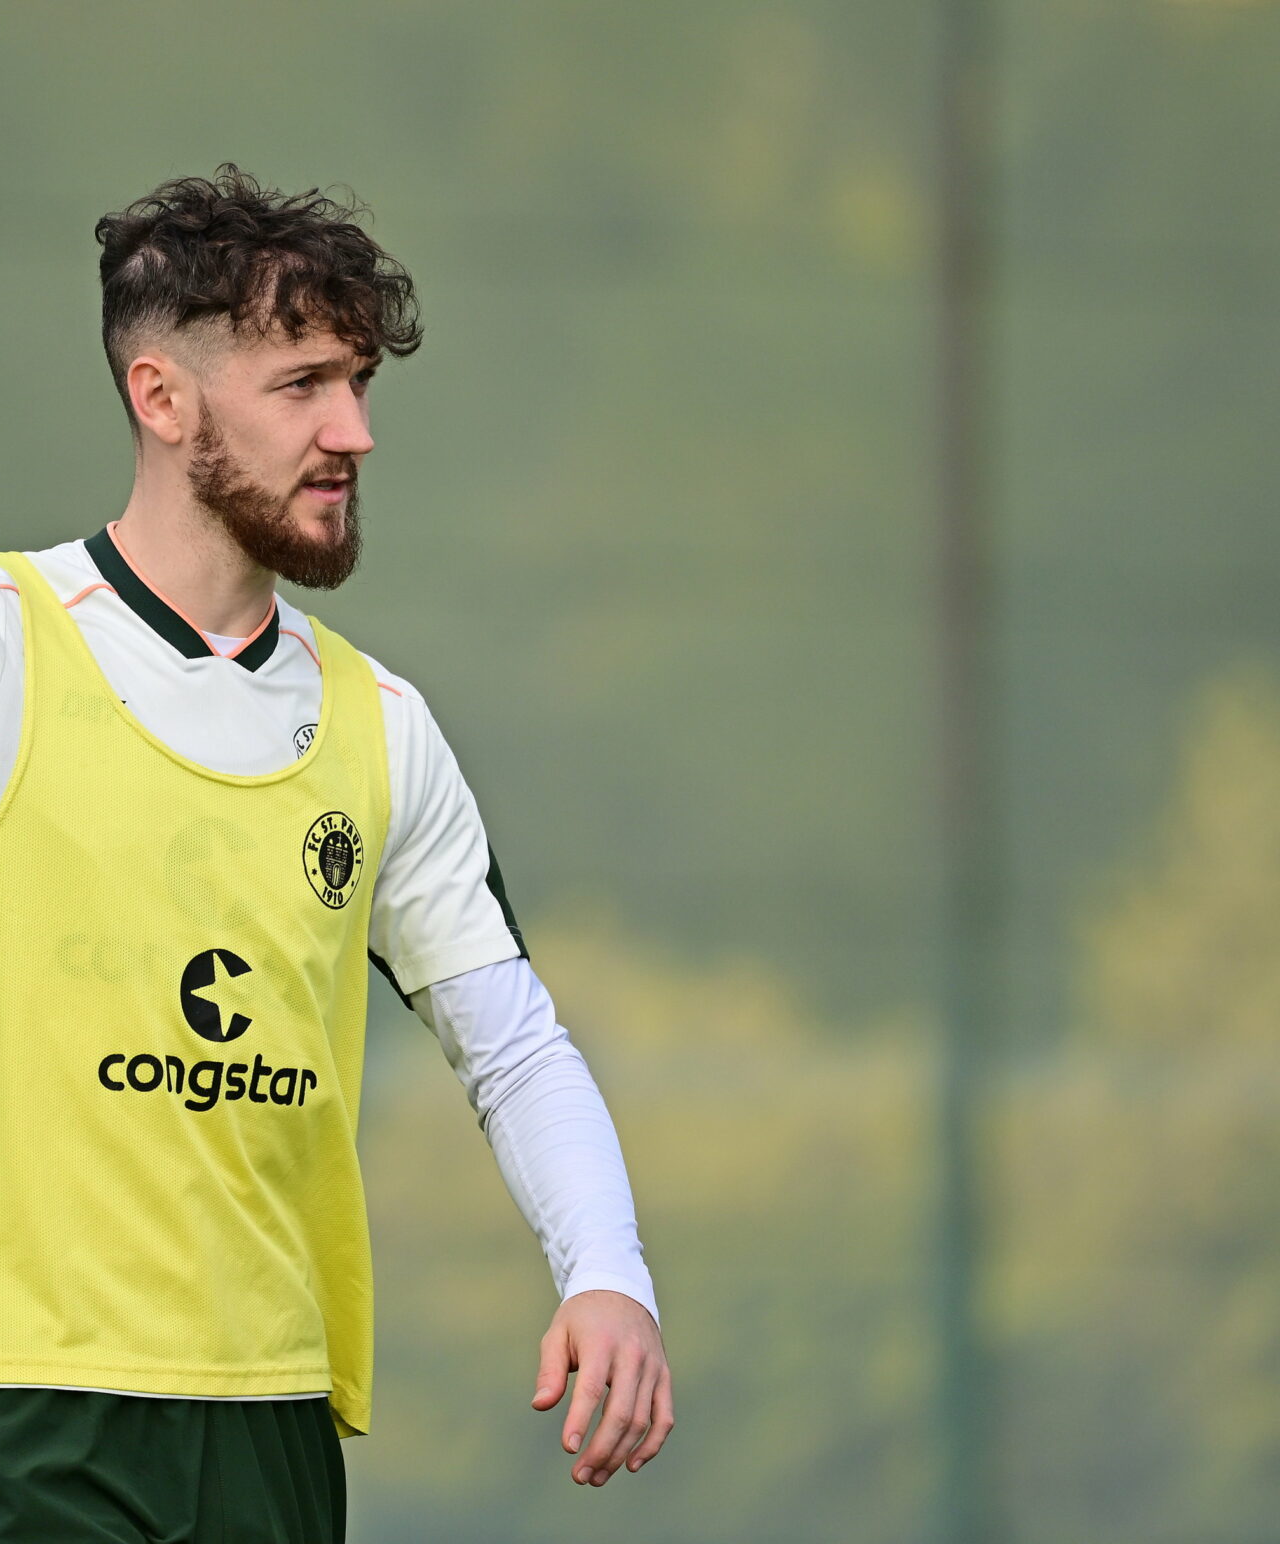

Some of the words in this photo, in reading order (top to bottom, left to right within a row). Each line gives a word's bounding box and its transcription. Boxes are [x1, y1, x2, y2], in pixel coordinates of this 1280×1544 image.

[308, 832, 322, 852] FC
[321, 817, 337, 834] ST.
[341, 817, 362, 864] PAULI
[322, 886, 344, 905] 1910
[98, 1053, 318, 1112] congstar
